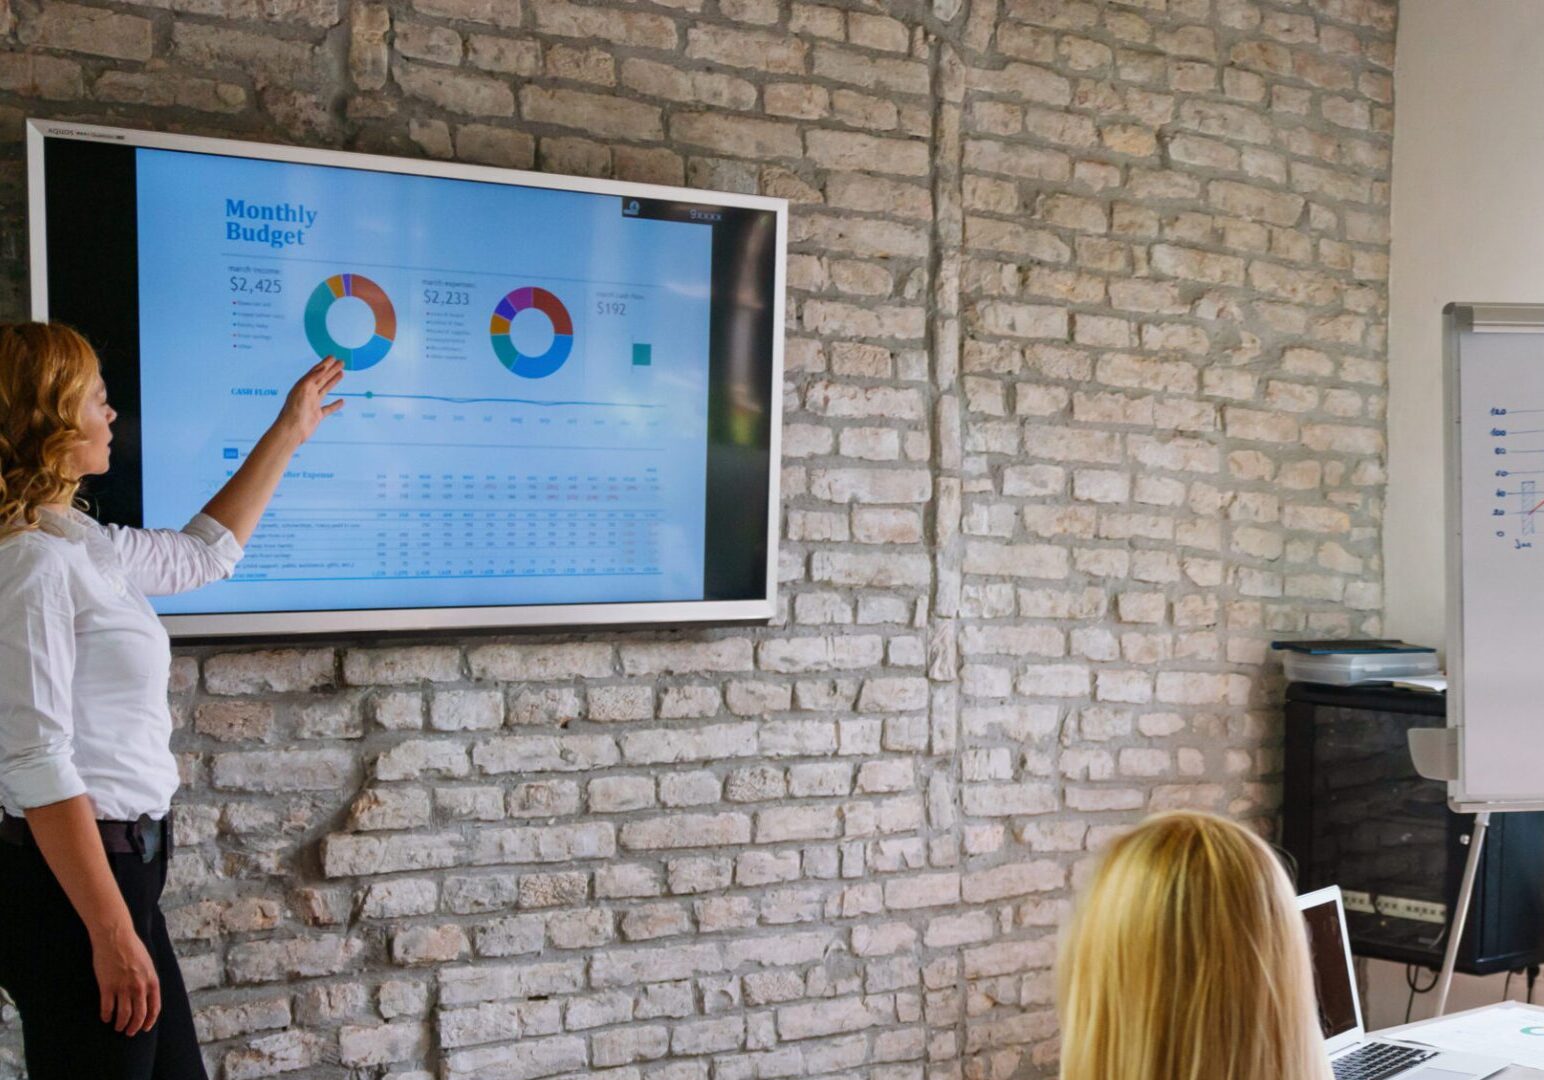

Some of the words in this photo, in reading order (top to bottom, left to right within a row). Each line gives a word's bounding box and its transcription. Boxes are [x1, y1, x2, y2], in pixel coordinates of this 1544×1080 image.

[226, 199, 317, 228] Monthly
[226, 221, 304, 248] Budget
[230, 276, 282, 295] $2,425
[424, 289, 469, 306] $2,233
[1496, 530, 1505, 538] 0
